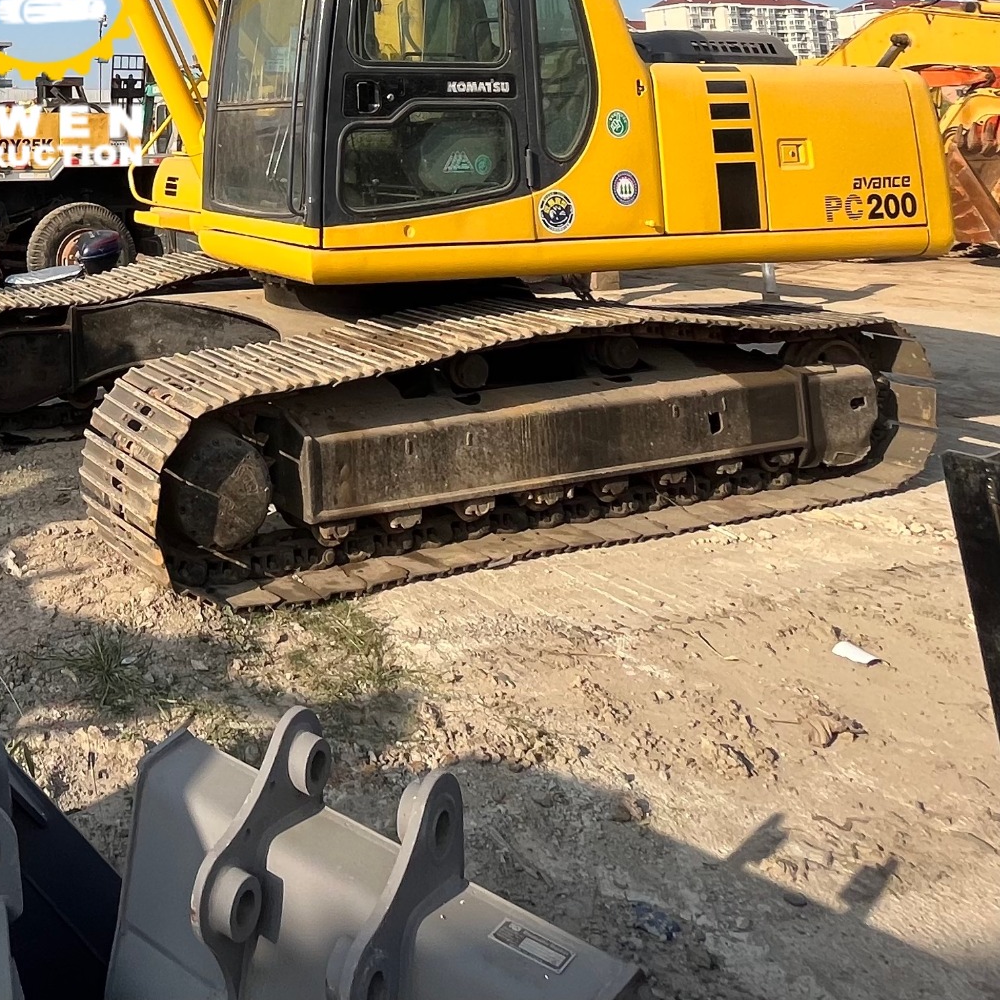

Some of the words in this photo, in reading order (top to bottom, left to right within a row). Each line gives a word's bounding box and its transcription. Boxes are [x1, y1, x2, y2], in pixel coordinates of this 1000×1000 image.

[446, 78, 510, 93] KOMATSU
[853, 175, 910, 190] avance
[824, 192, 917, 222] PC200
